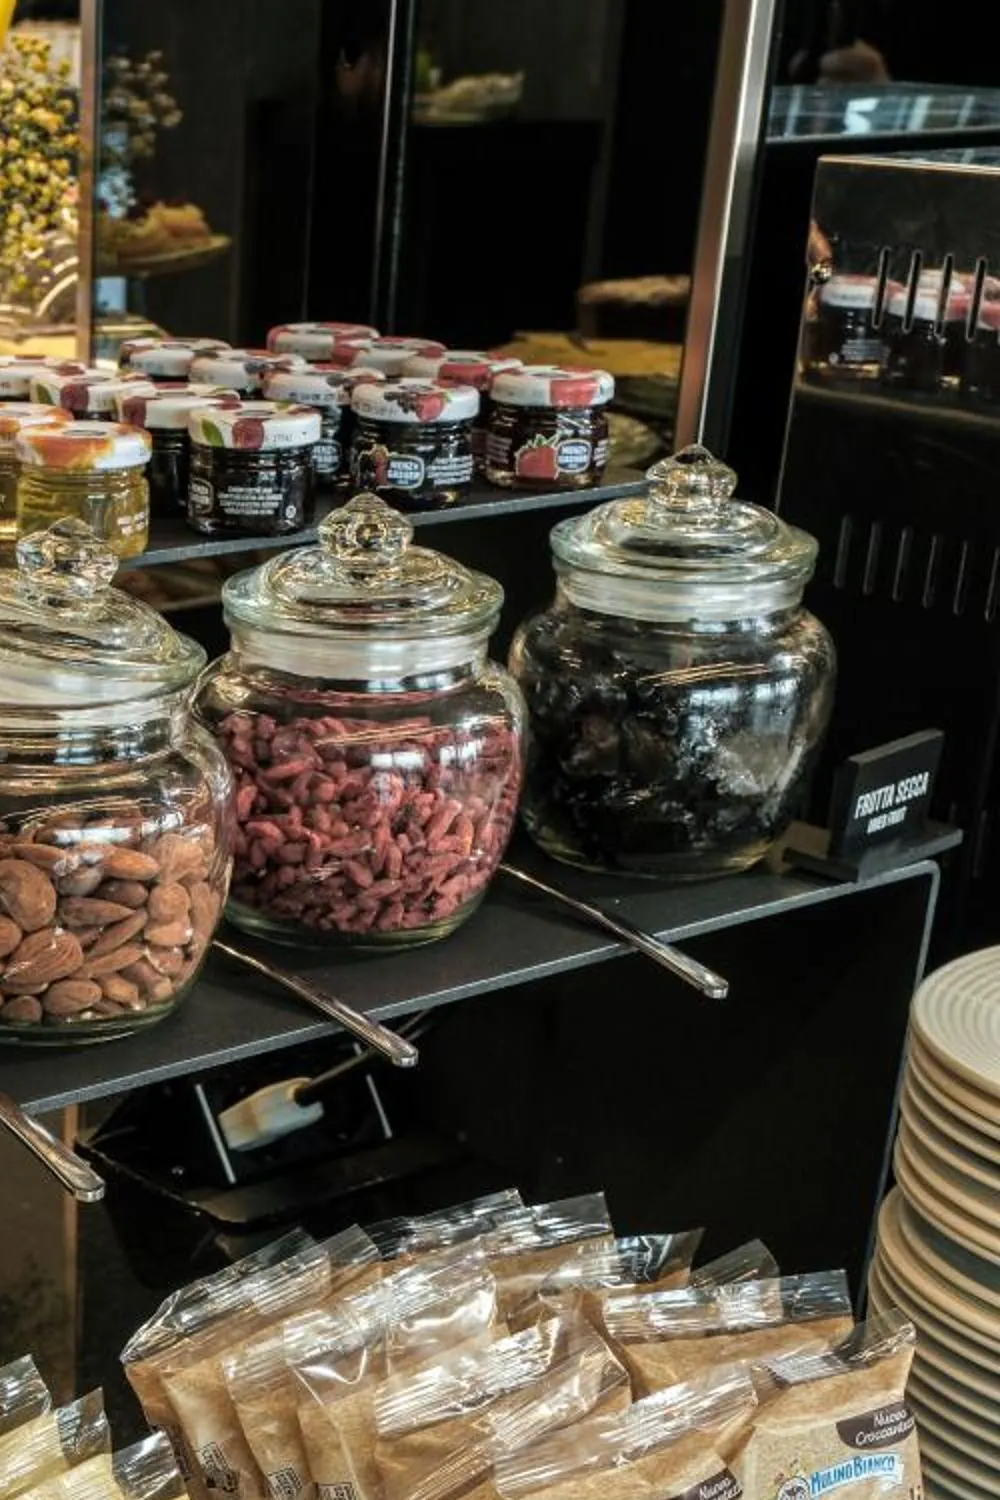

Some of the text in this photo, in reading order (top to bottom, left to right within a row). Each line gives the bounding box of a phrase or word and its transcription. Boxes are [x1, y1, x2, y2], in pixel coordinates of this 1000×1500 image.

[854, 771, 929, 820] FRUTTA SECCA
[810, 1456, 895, 1495] MULINO BIANCO
